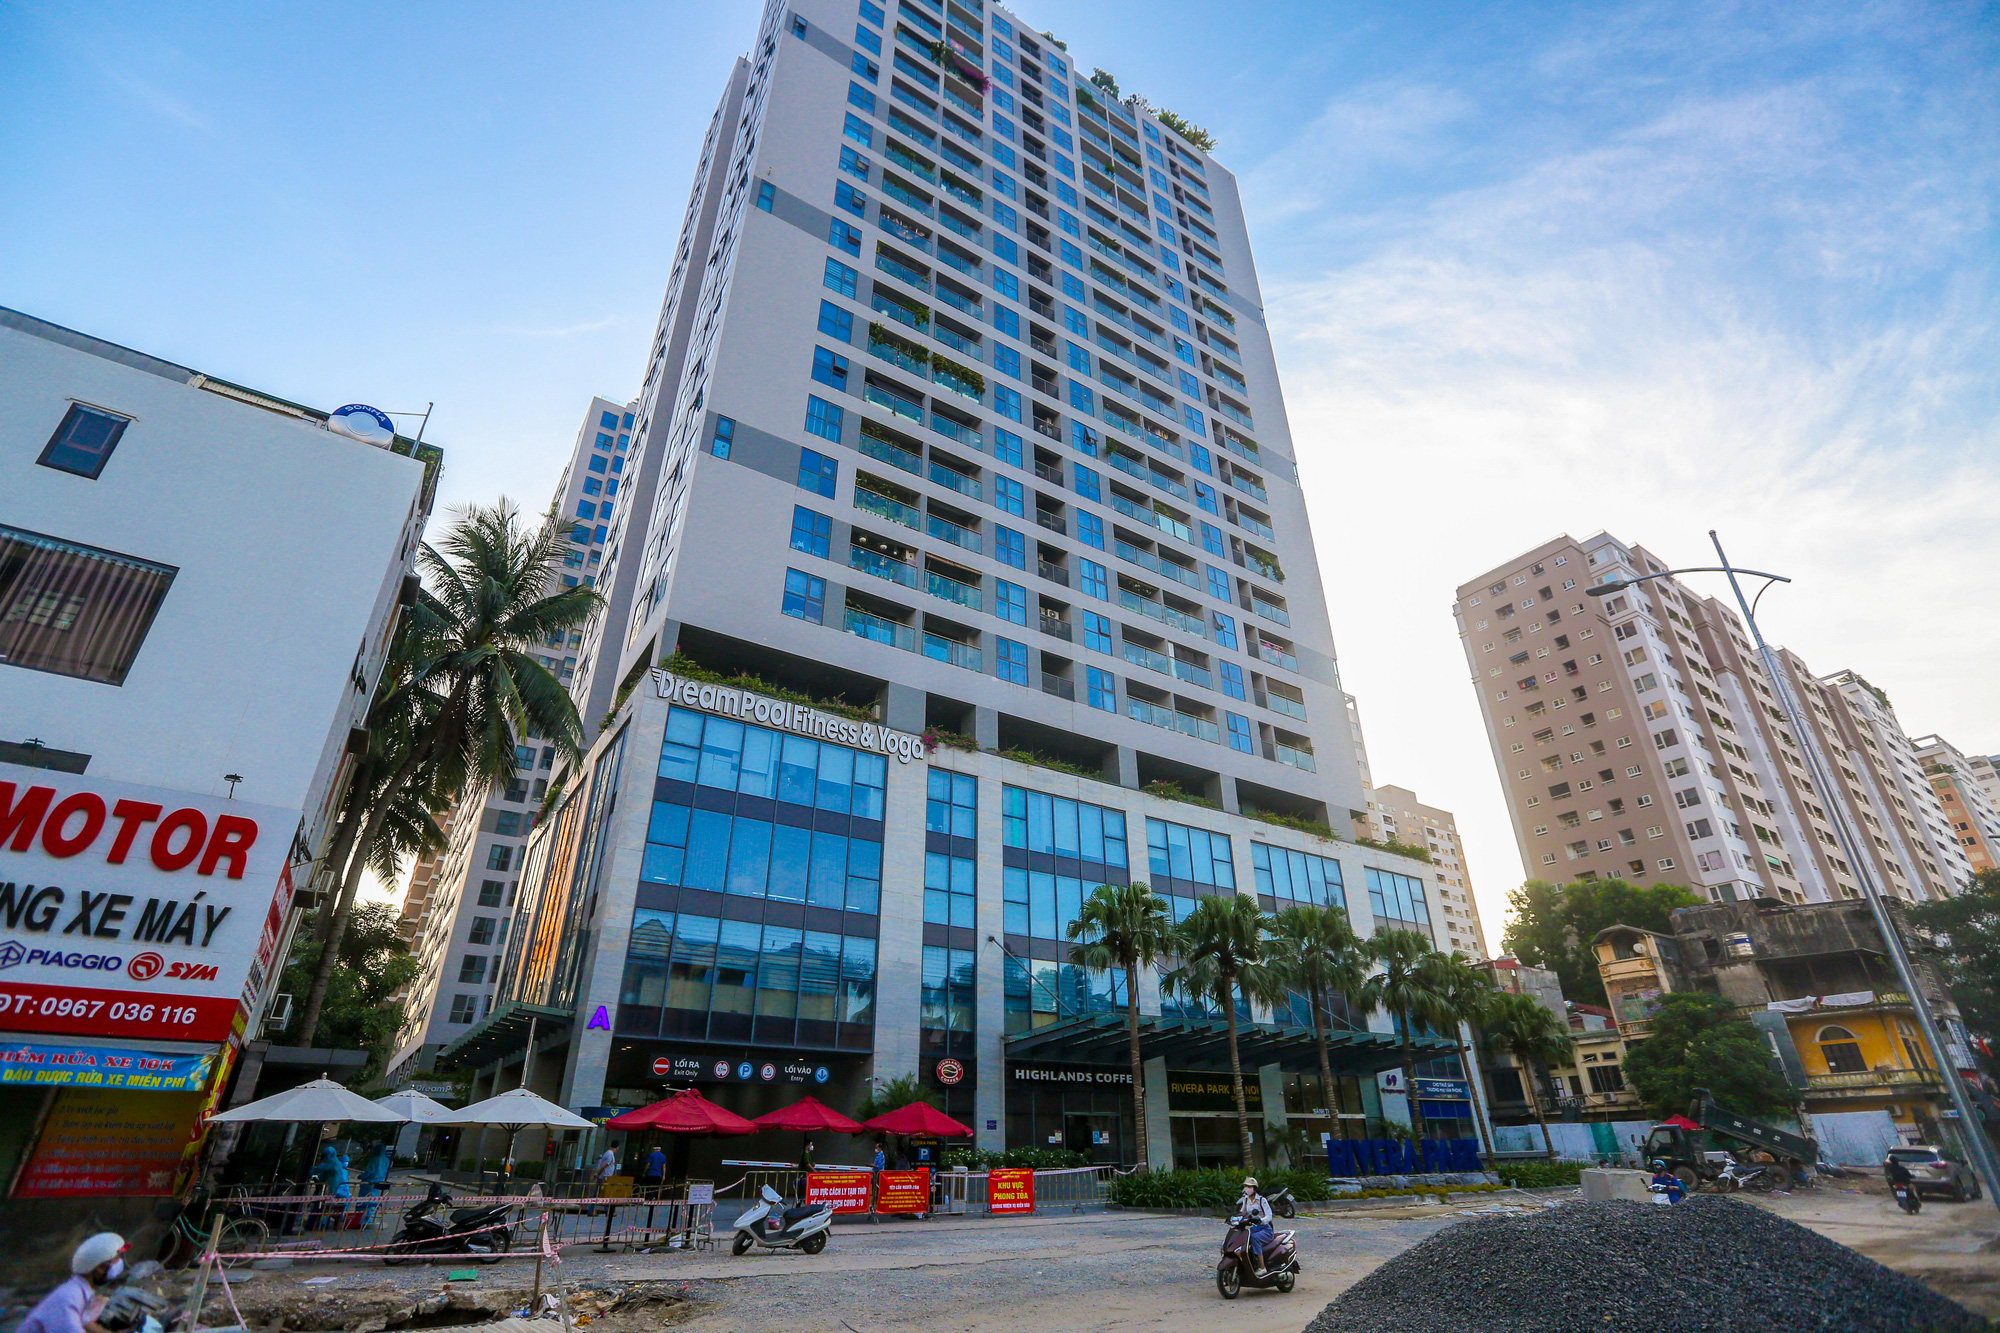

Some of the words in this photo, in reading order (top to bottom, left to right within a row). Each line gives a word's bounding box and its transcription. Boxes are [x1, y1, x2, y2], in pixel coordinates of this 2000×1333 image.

[860, 722, 874, 749] &
[877, 725, 924, 764] Yoga
[0, 781, 258, 879] MOTOR
[0, 882, 64, 932] NG
[63, 890, 134, 939] XE
[133, 891, 232, 947] MÁY
[26, 949, 122, 971] PIAGGIO
[164, 962, 219, 981] SYM
[40, 997, 105, 1018] 0967
[109, 1002, 154, 1022] 036
[161, 1006, 197, 1024] 116
[587, 1006, 610, 1030] A
[51, 1051, 97, 1067] RỬA
[103, 1056, 132, 1069] XE
[138, 1058, 176, 1071] 10K
[688, 1061, 700, 1069] RA
[784, 1064, 796, 1074] LỐI
[797, 1066, 812, 1075] VÀO
[75, 1068, 103, 1084] RỬA
[106, 1073, 124, 1085] XE
[163, 1075, 187, 1088] PHÍ
[1015, 1069, 1093, 1083] HIGHLANDS
[1096, 1073, 1133, 1084] COFFE
[1171, 1082, 1205, 1093] RIVERA
[1206, 1084, 1230, 1094] PARK
[920, 1148, 929, 1160] P
[1326, 1138, 1424, 1176] RIVERA
[1421, 1138, 1485, 1174] PARK
[810, 1188, 819, 1196] KHU
[820, 1187, 828, 1197] VỰC
[829, 1186, 841, 1196] CÁCH
[841, 1187, 848, 1196] LY
[848, 1187, 857, 1197] TẠM
[997, 1181, 1011, 1190] KHU
[1012, 1181, 1025, 1190] VỰC
[844, 1199, 857, 1207] COVID
[993, 1192, 1015, 1200] PHONG
